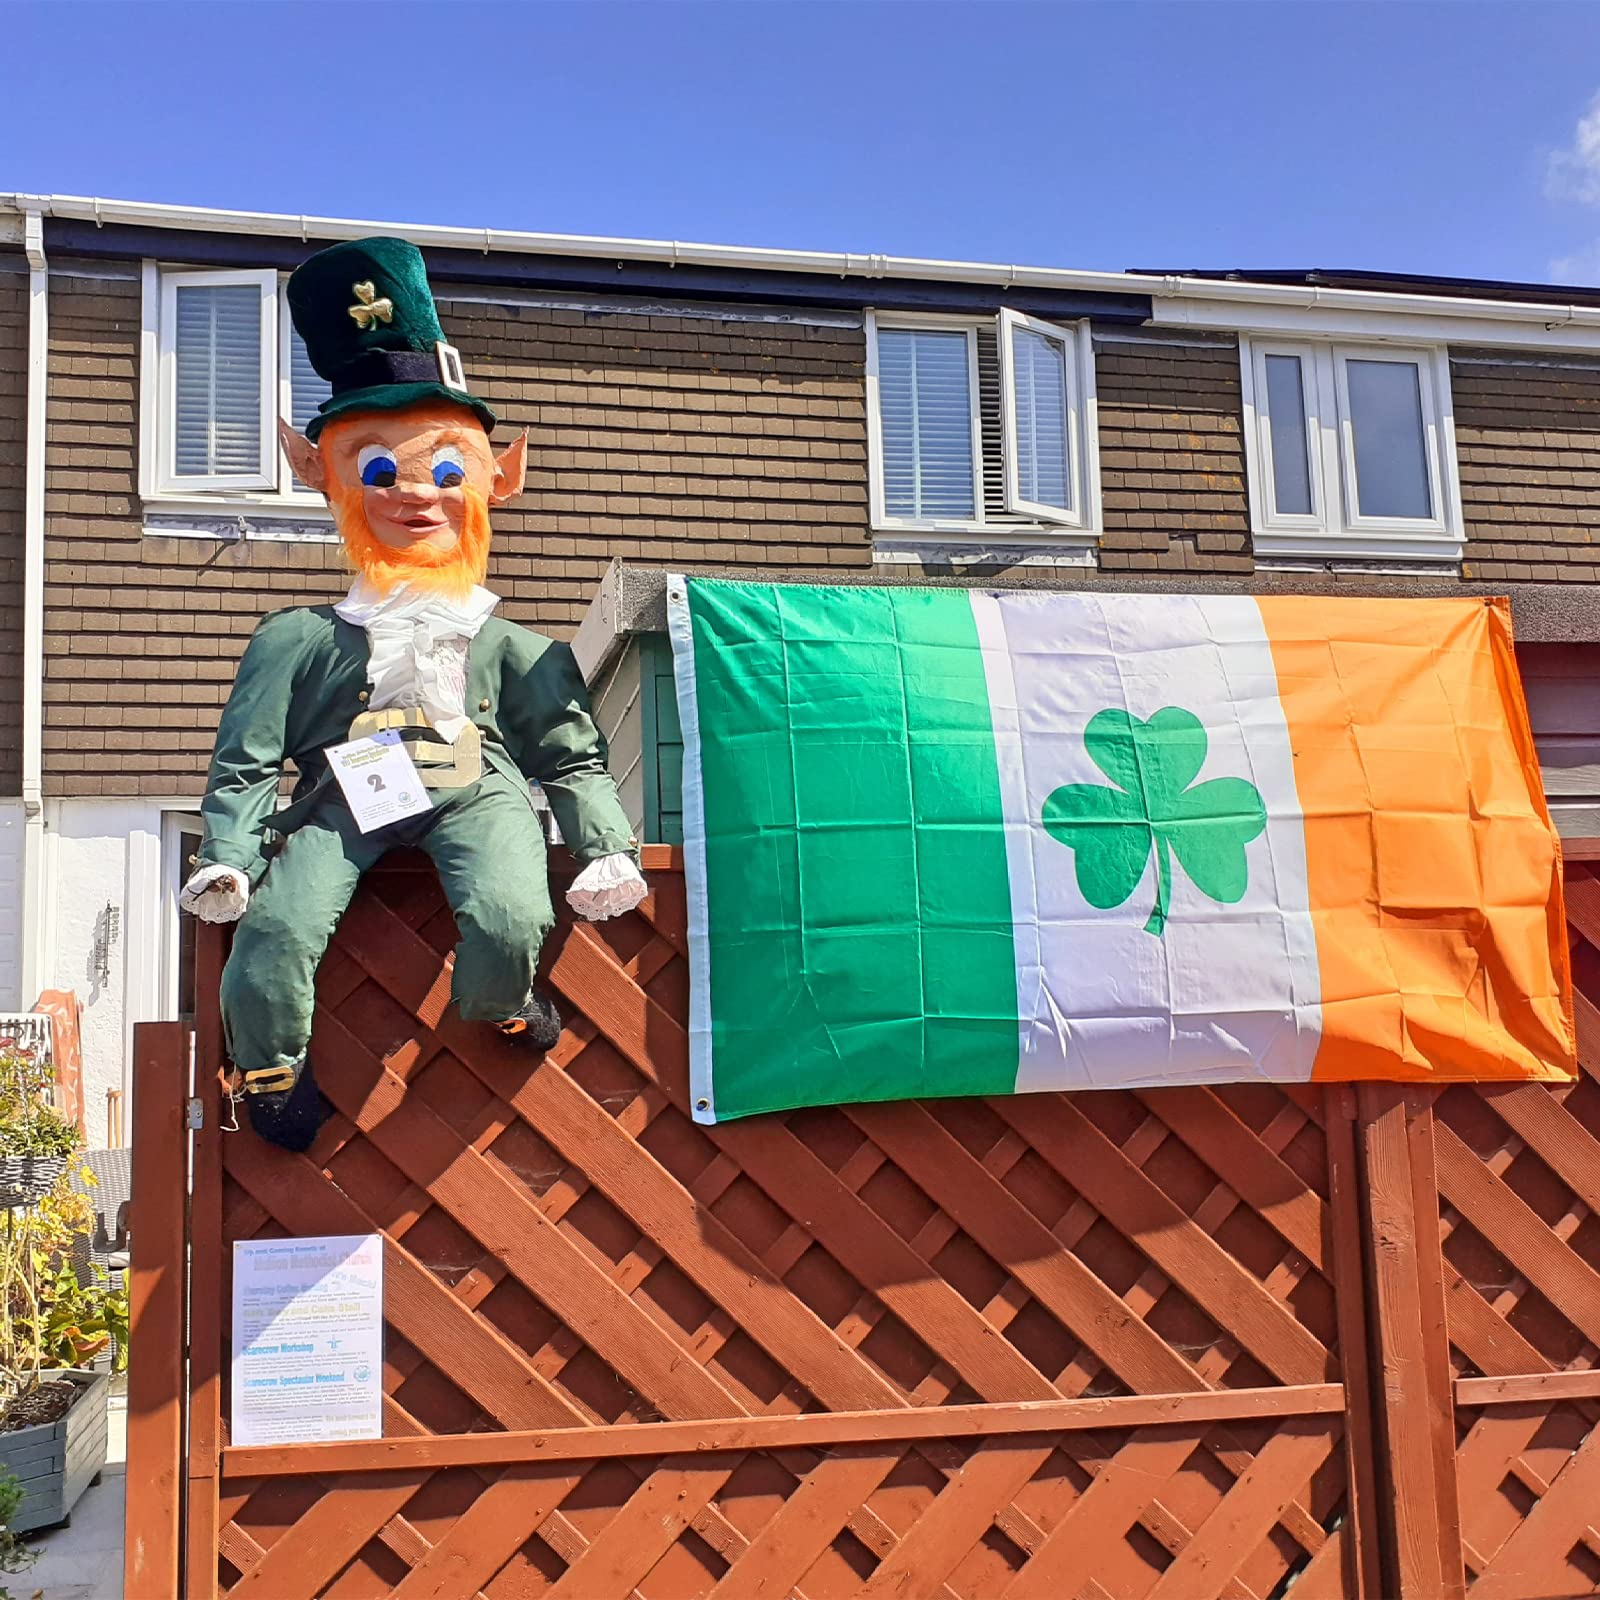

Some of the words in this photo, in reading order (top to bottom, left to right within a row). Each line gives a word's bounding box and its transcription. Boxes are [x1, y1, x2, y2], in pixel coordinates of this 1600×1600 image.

[367, 774, 386, 792] 2
[242, 1345, 279, 1356] Scarecrow
[280, 1343, 314, 1354] Workshop
[243, 1377, 278, 1388] Scarecrow
[316, 1371, 345, 1383] Weekend
